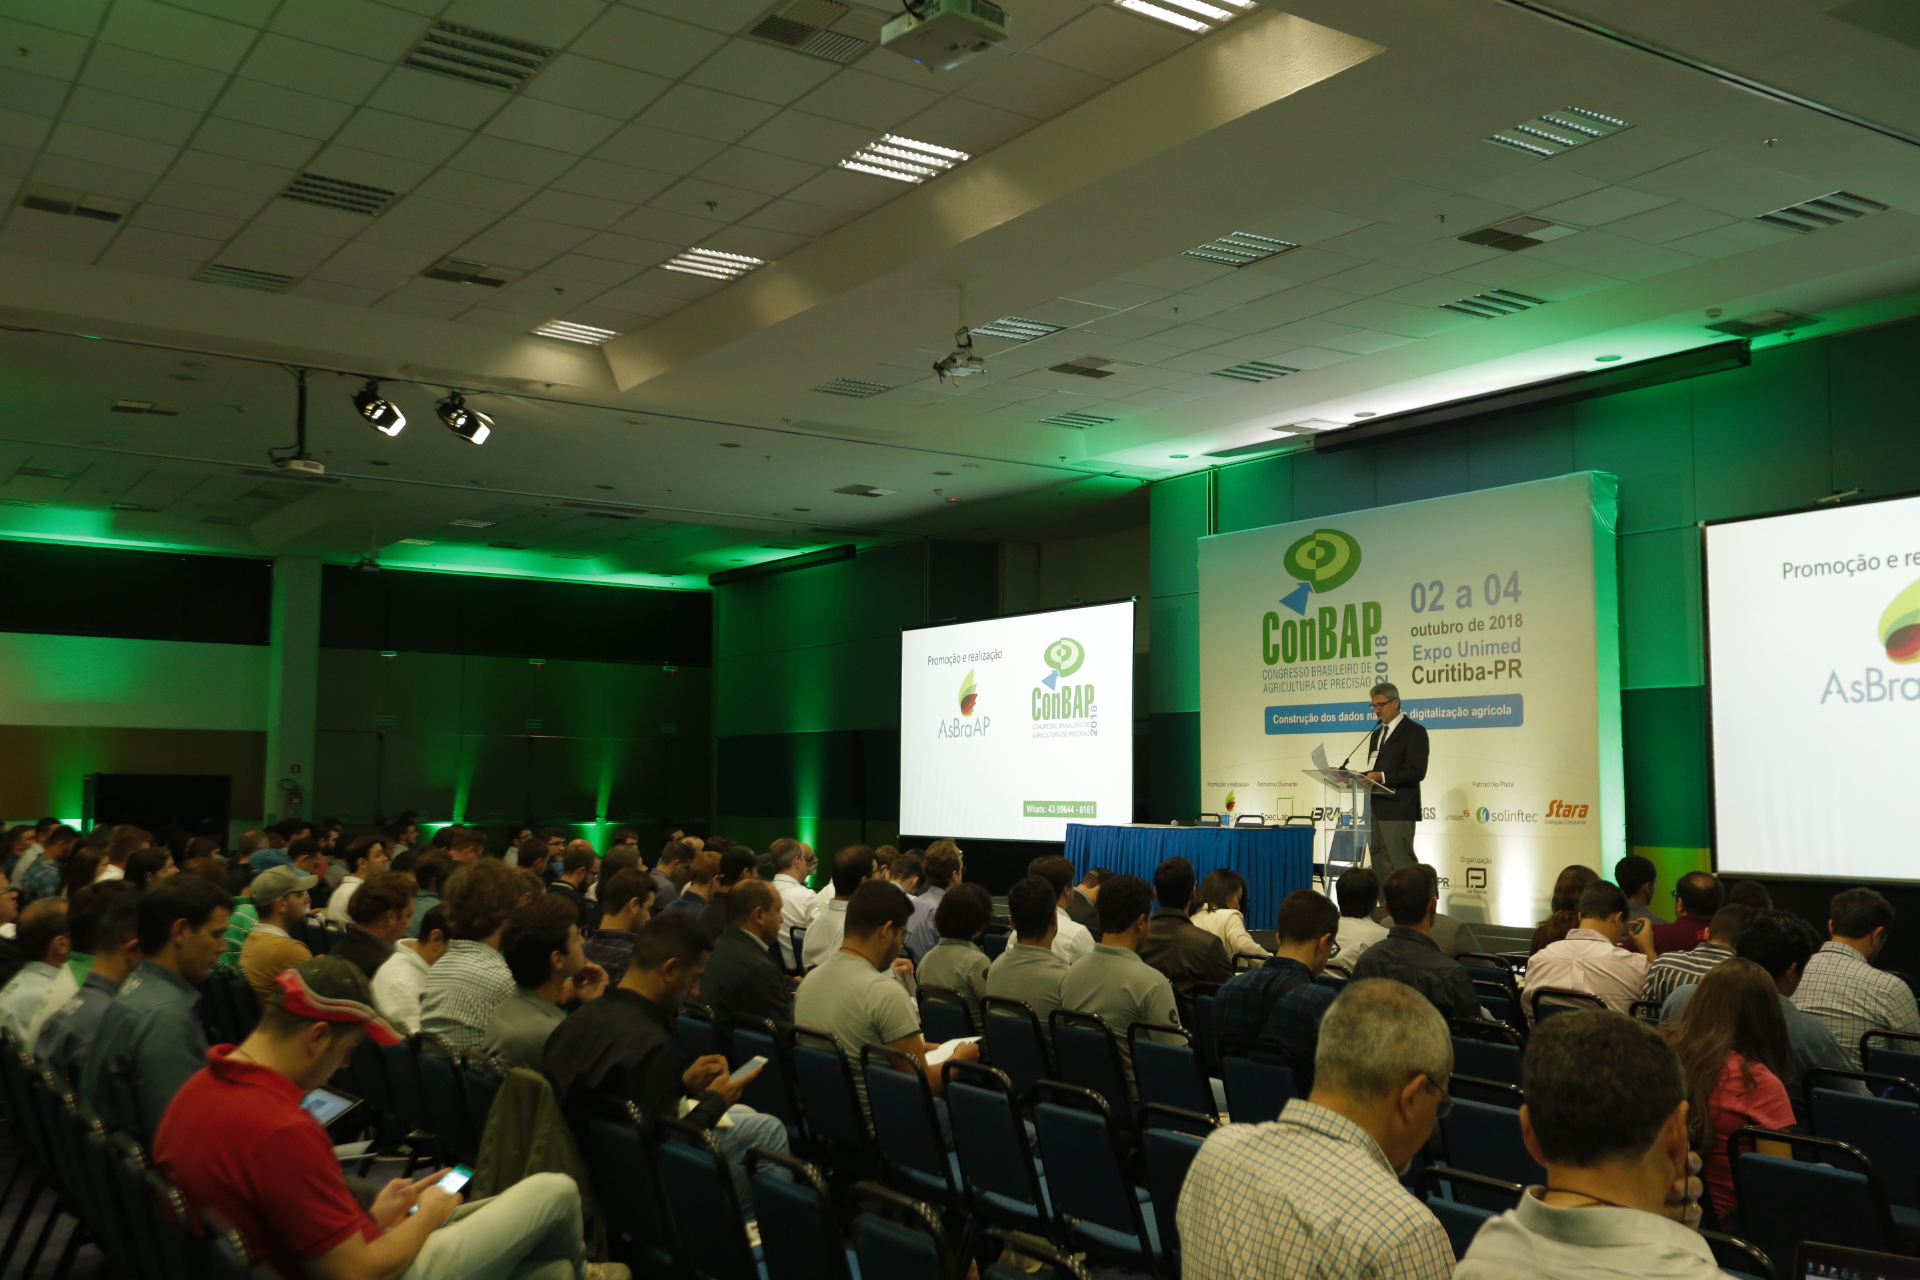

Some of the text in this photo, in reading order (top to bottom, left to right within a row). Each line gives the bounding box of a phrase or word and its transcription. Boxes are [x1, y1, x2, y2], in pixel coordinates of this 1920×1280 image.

[1783, 554, 1881, 579] Promoção
[1887, 554, 1898, 568] e
[1410, 570, 1522, 614] 02 a 04
[1262, 601, 1382, 666] ConBAP
[1411, 613, 1523, 637] outubro de 2018
[927, 649, 1003, 666] Promoção e realização
[1413, 636, 1521, 663] Expo Unimed
[1375, 635, 1389, 685] 2018
[1262, 662, 1372, 681] CONGRESSO BRASILEIRO DE
[1411, 658, 1523, 684] Curitiba-PR
[1263, 675, 1372, 694] AGRICULTURA DE PRECISÃO
[1820, 667, 1920, 704] AsBra
[1031, 684, 1095, 721] ConBAP
[1090, 704, 1098, 737] 2018
[1273, 713, 1319, 725] Construção
[1320, 712, 1336, 722] dos
[1338, 711, 1365, 722] dados
[1409, 707, 1469, 721] digitalização
[1471, 704, 1512, 719] agrícola
[937, 716, 991, 739] AsBraAP
[1031, 731, 1061, 739] AGRICULTURA
[1068, 729, 1091, 738] PRECISÃO
[1084, 721, 1091, 729] DE
[1026, 804, 1046, 814] Whats:
[1048, 805, 1055, 814] 43
[1056, 805, 1074, 814] 99644
[1079, 805, 1094, 814] 6161
[1421, 806, 1437, 820] GS
[1491, 809, 1539, 823] solinftec
[1545, 799, 1589, 818] Stara
[1460, 856, 1493, 865] Organização
